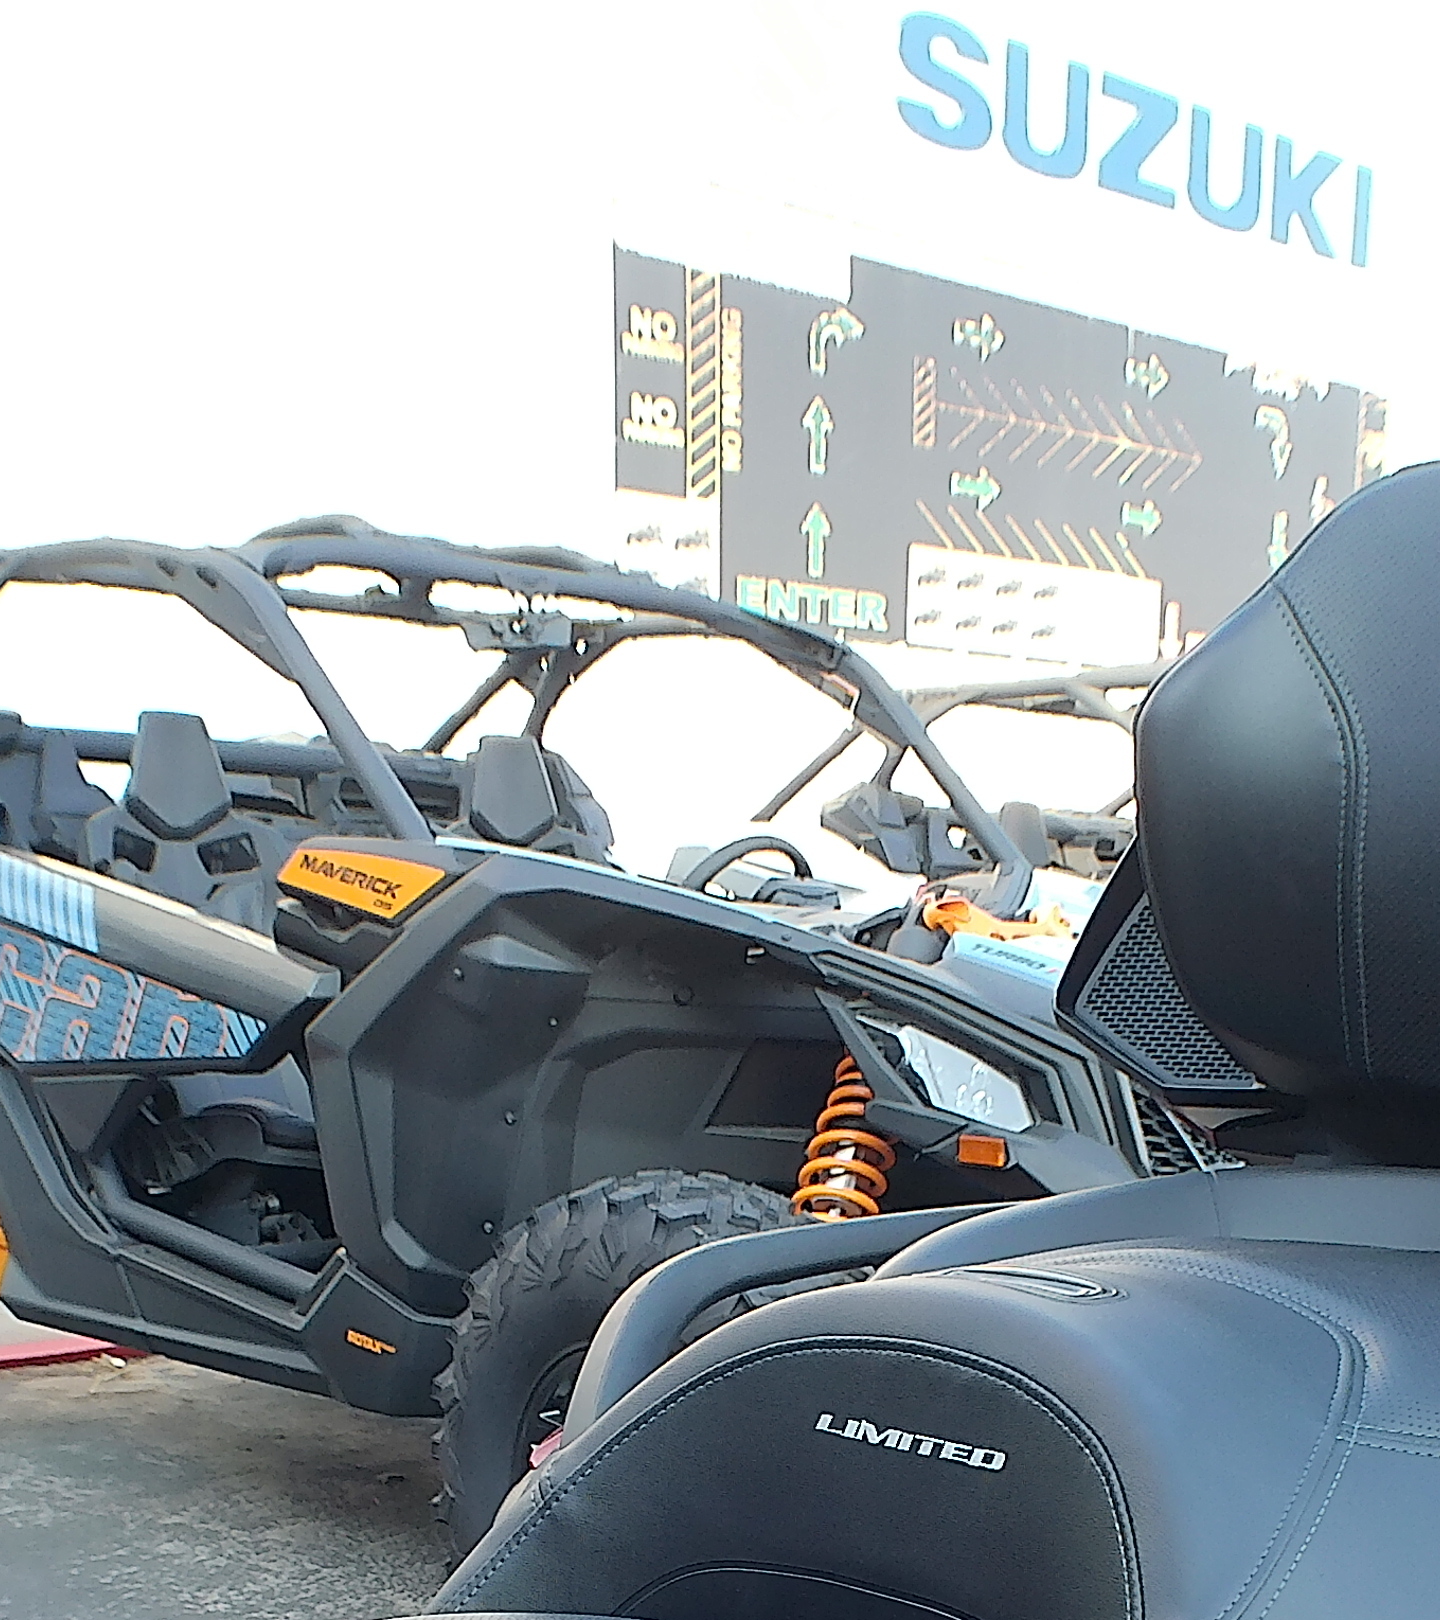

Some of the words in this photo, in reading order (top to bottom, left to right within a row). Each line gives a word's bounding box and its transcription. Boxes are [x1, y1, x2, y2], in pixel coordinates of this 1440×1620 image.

[897, 11, 1372, 268] SUZUKI
[629, 304, 678, 342] NO
[630, 391, 678, 429] NO
[737, 575, 889, 632] ENTER
[300, 853, 403, 899] MAVERICK
[814, 1413, 1007, 1471] LIMITED
